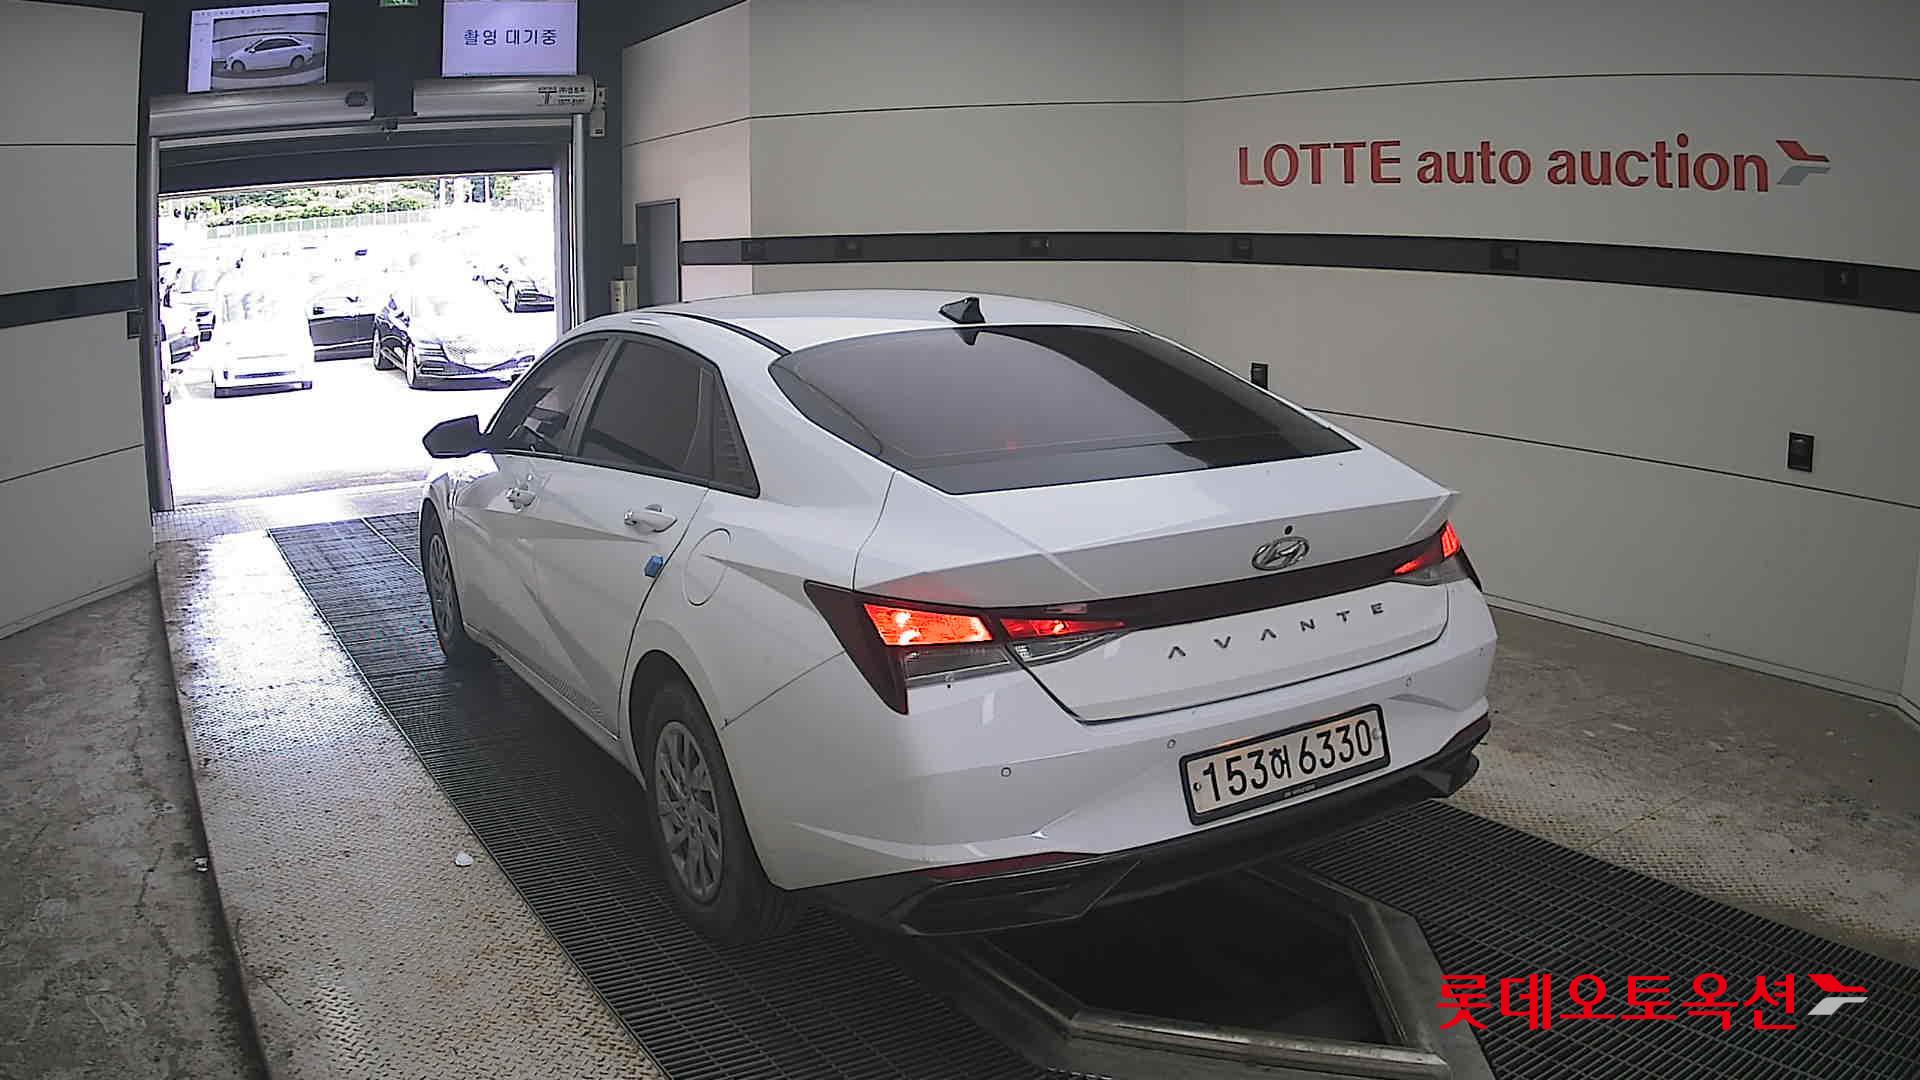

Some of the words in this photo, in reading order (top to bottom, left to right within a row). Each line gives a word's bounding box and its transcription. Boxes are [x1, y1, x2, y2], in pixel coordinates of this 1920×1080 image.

[464, 29, 497, 46] 촬영
[505, 29, 558, 46] 대기중
[1239, 140, 1401, 186] LOTTE
[1417, 141, 1532, 184] auto
[1548, 133, 1769, 192] auction
[1167, 602, 1384, 660] AVANTE
